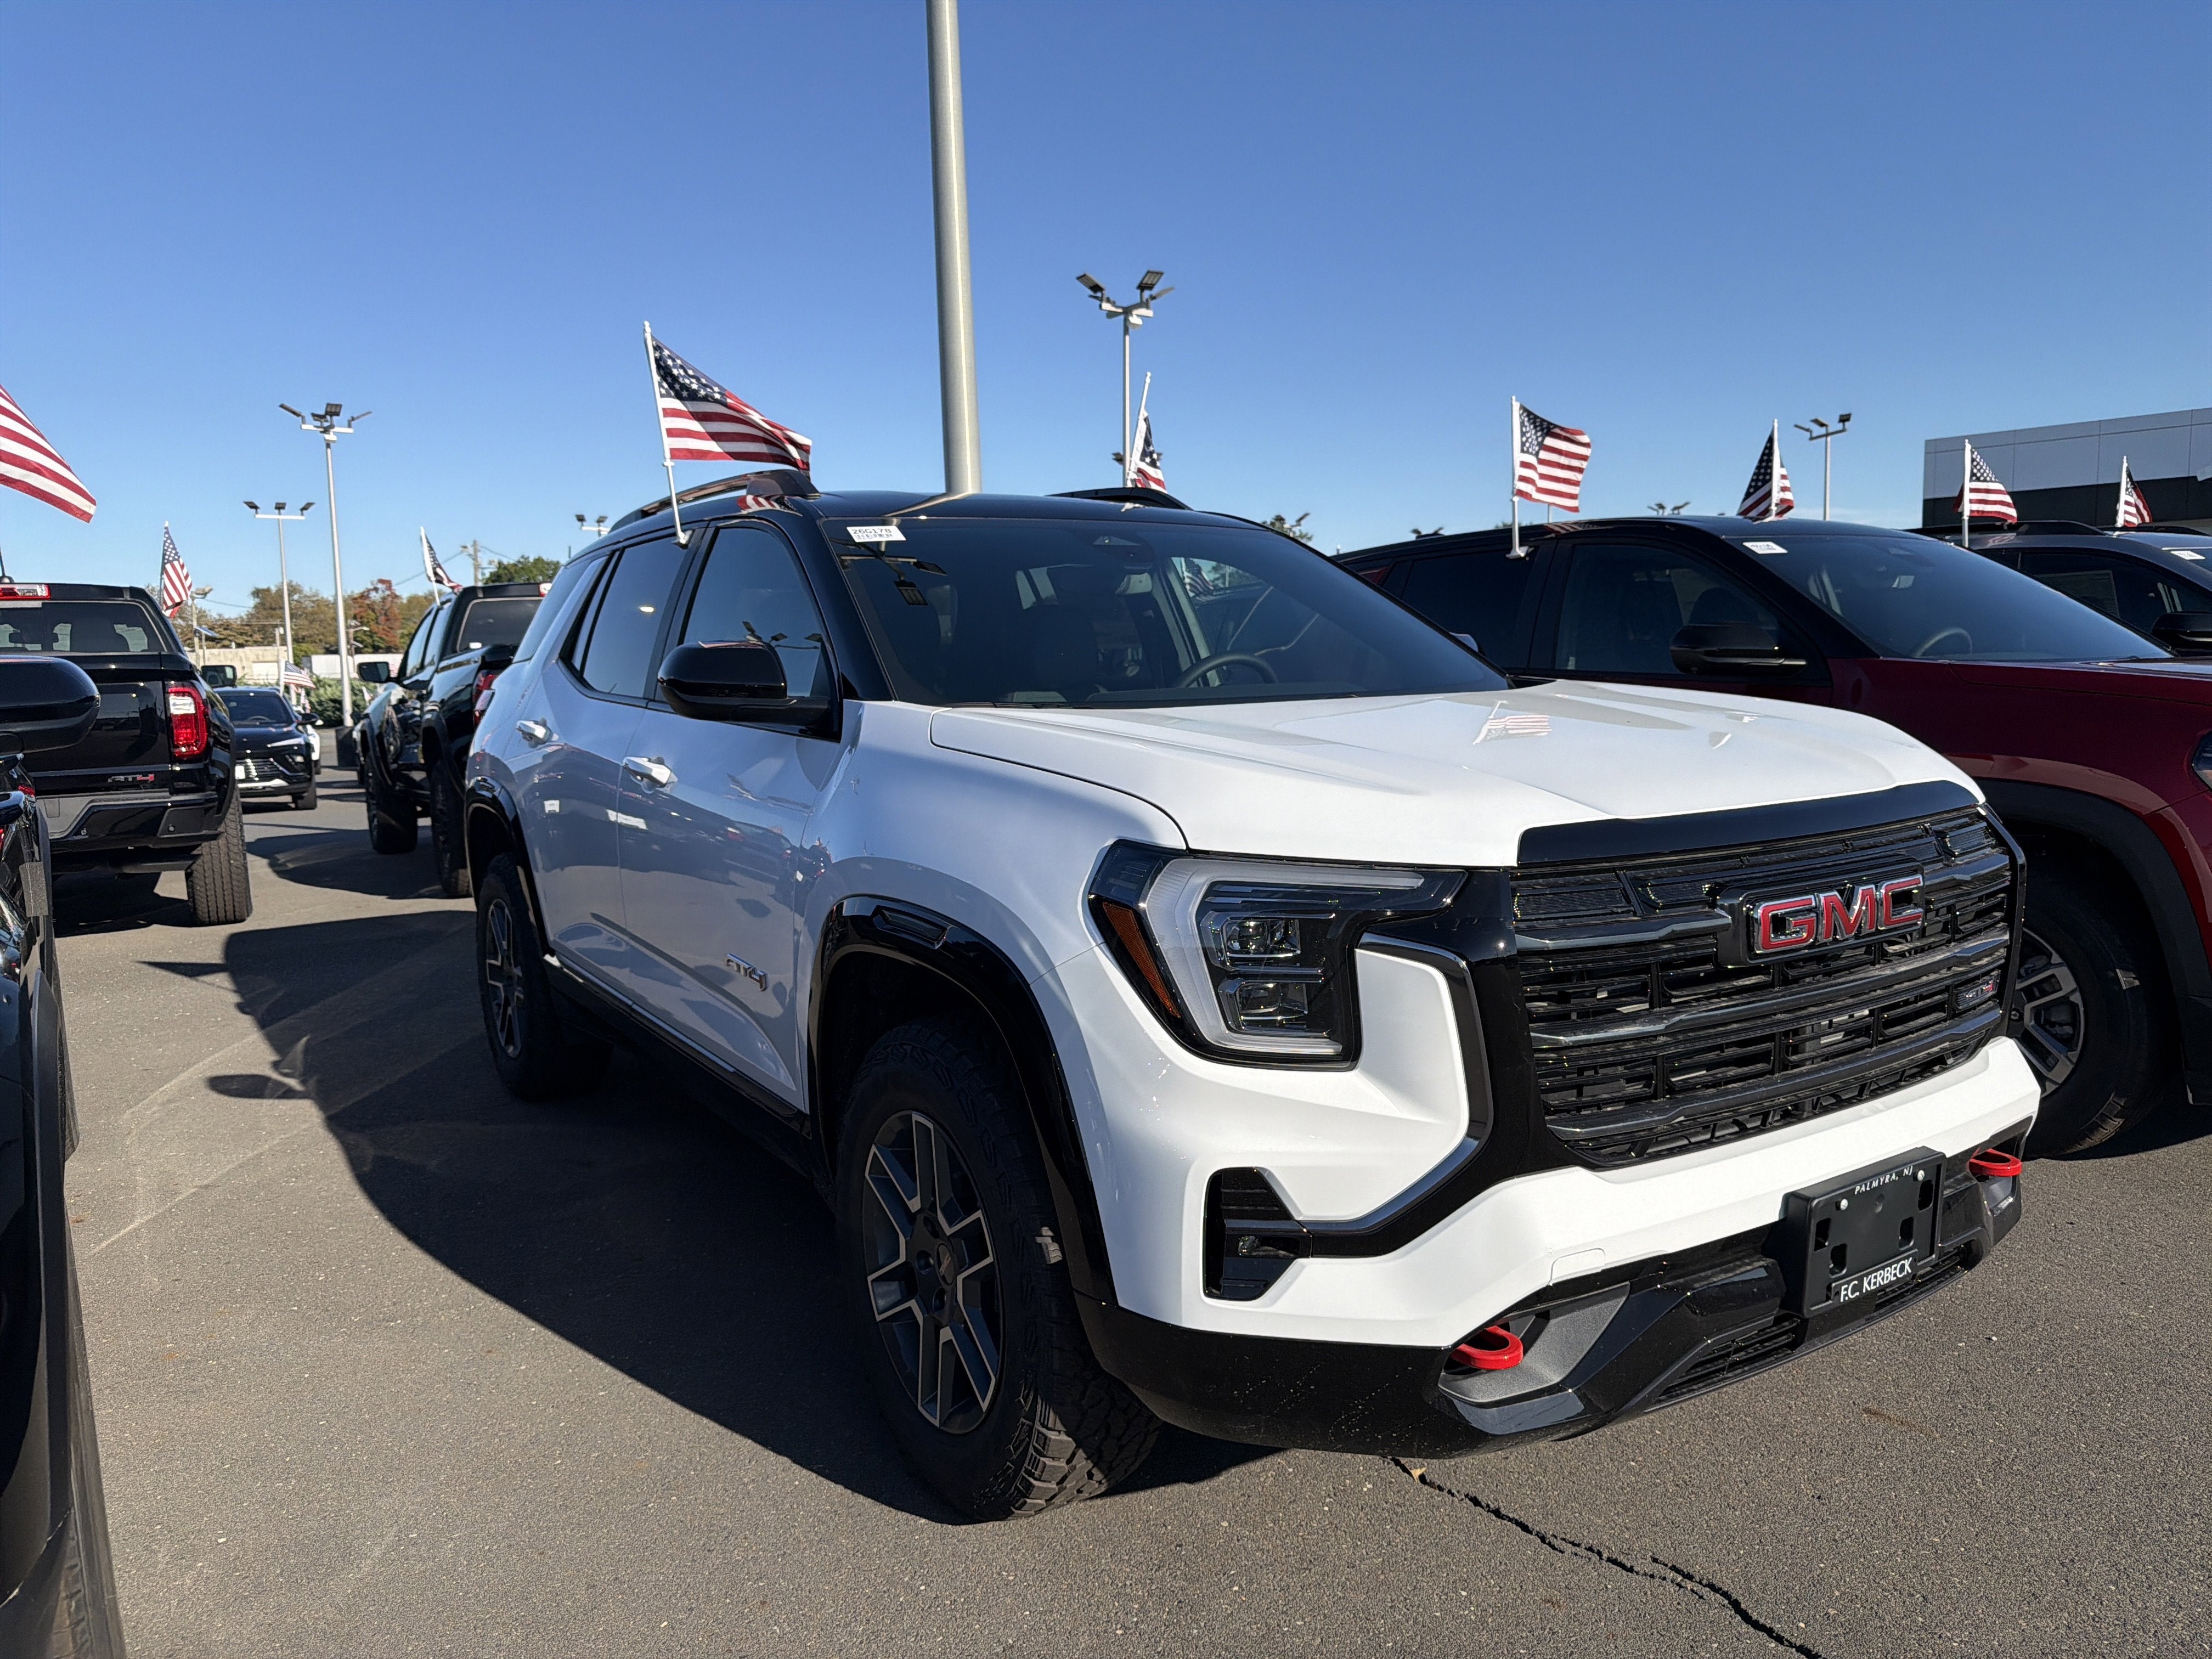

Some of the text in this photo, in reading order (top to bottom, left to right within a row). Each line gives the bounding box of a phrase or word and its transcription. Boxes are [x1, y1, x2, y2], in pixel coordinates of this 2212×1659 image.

[1756, 874, 1923, 953] GMC
[1854, 1165, 1914, 1195] PALMYRA, NJ
[1840, 1257, 1912, 1302] F.C. KERBECK
